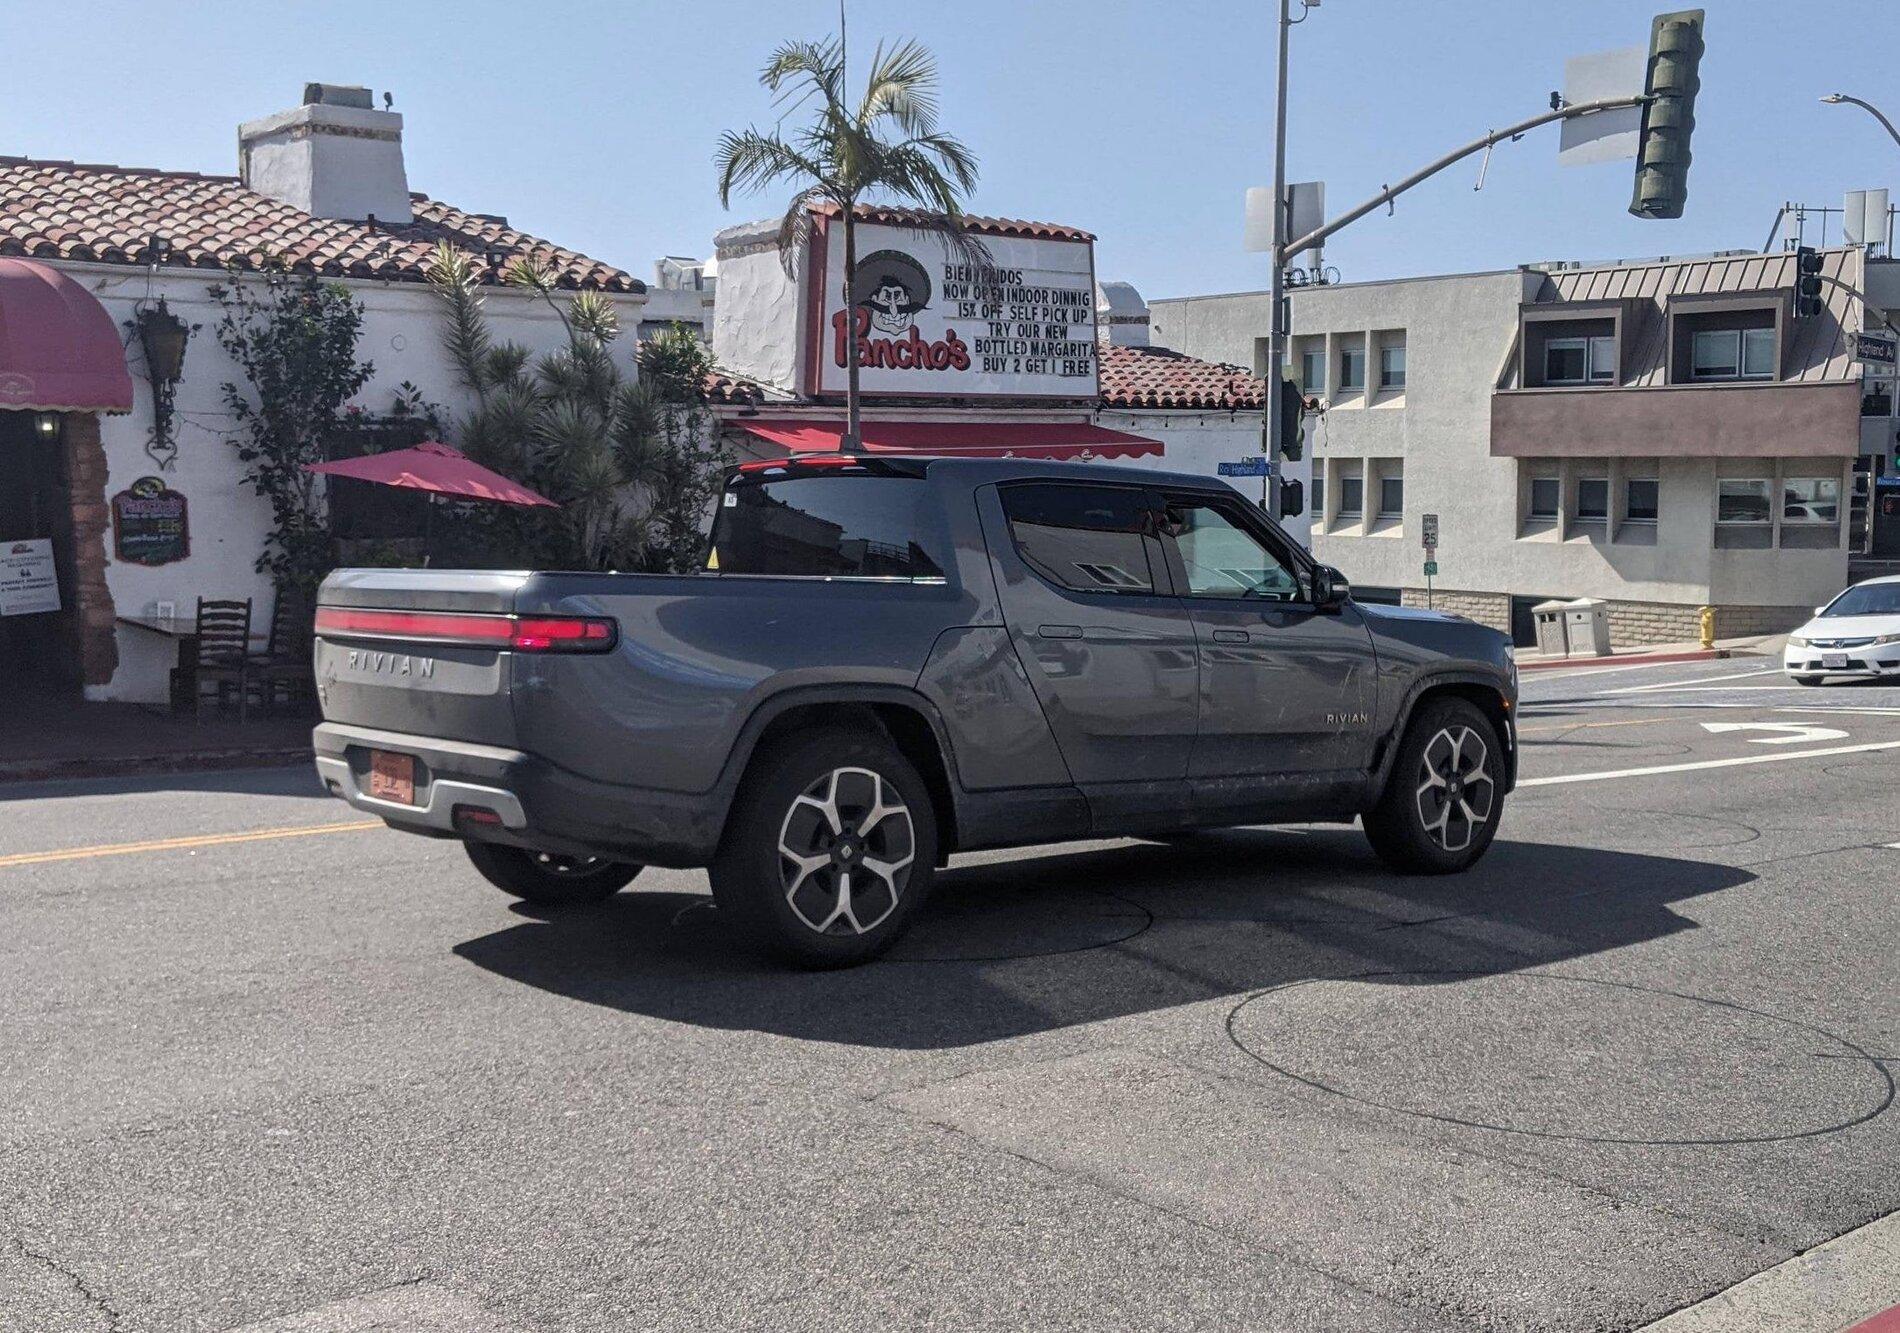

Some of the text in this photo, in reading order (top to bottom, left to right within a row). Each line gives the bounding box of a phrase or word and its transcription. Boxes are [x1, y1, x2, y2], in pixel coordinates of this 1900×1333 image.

[943, 283, 969, 299] NOW
[1006, 287, 1049, 304] INDOOR
[1052, 290, 1090, 306] DINNIG
[958, 302, 1088, 323] 15% OFF SELF PICK UP
[832, 305, 971, 371] Pancho's
[988, 322, 1068, 340] TRY OUR NEW
[975, 338, 1097, 357] BOTTLED MARGARITA
[983, 357, 1007, 372] BUY
[1014, 359, 1021, 373] 2
[1026, 359, 1047, 374] GET
[1063, 361, 1090, 375] FREE
[1424, 532, 1436, 545] 25
[349, 650, 434, 679] RIVIAN
[1326, 712, 1368, 725] RIVIAN
